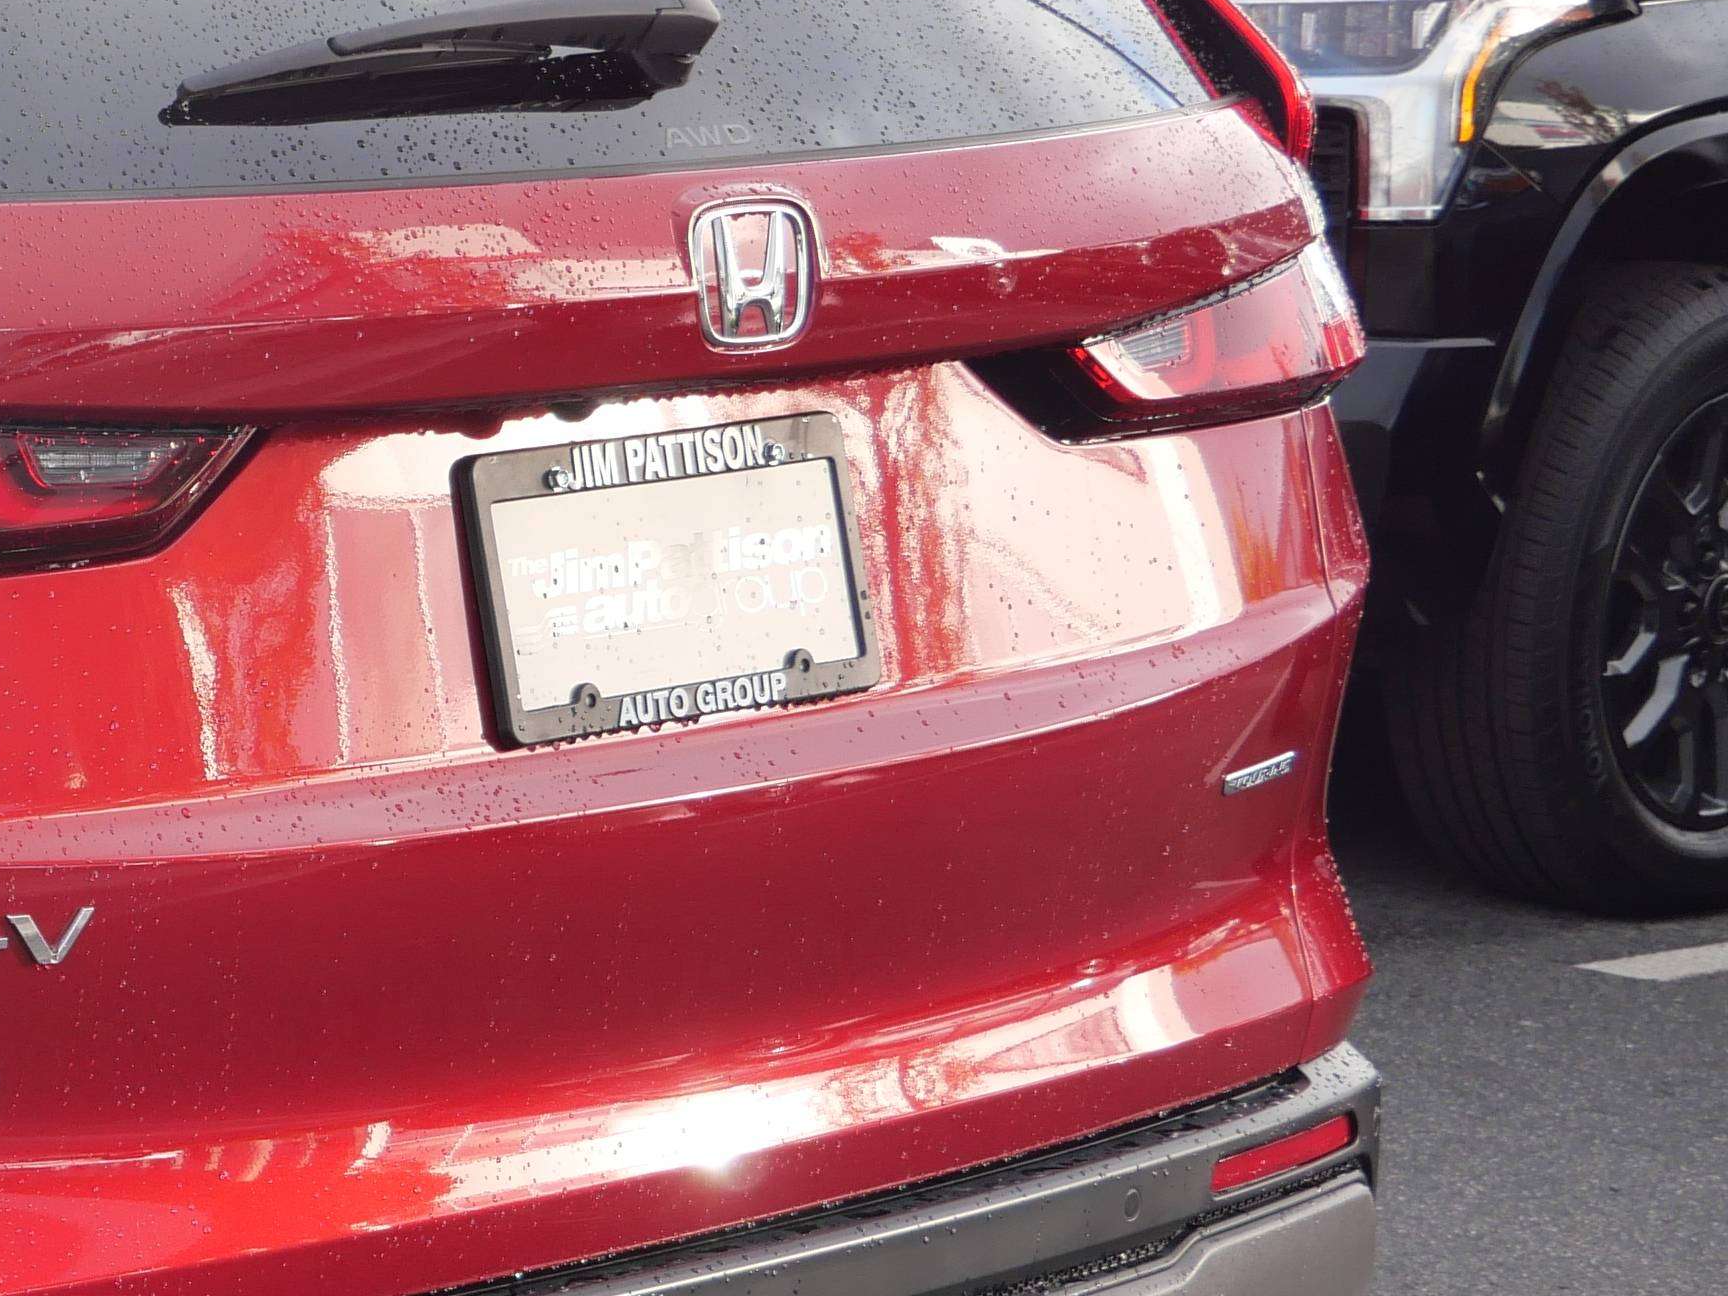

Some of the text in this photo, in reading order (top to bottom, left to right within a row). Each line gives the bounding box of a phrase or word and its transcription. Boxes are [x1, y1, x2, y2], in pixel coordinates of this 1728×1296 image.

[665, 124, 750, 148] AWD
[568, 424, 767, 491] JIM PATTISON
[618, 672, 787, 727] AUTO GROUP
